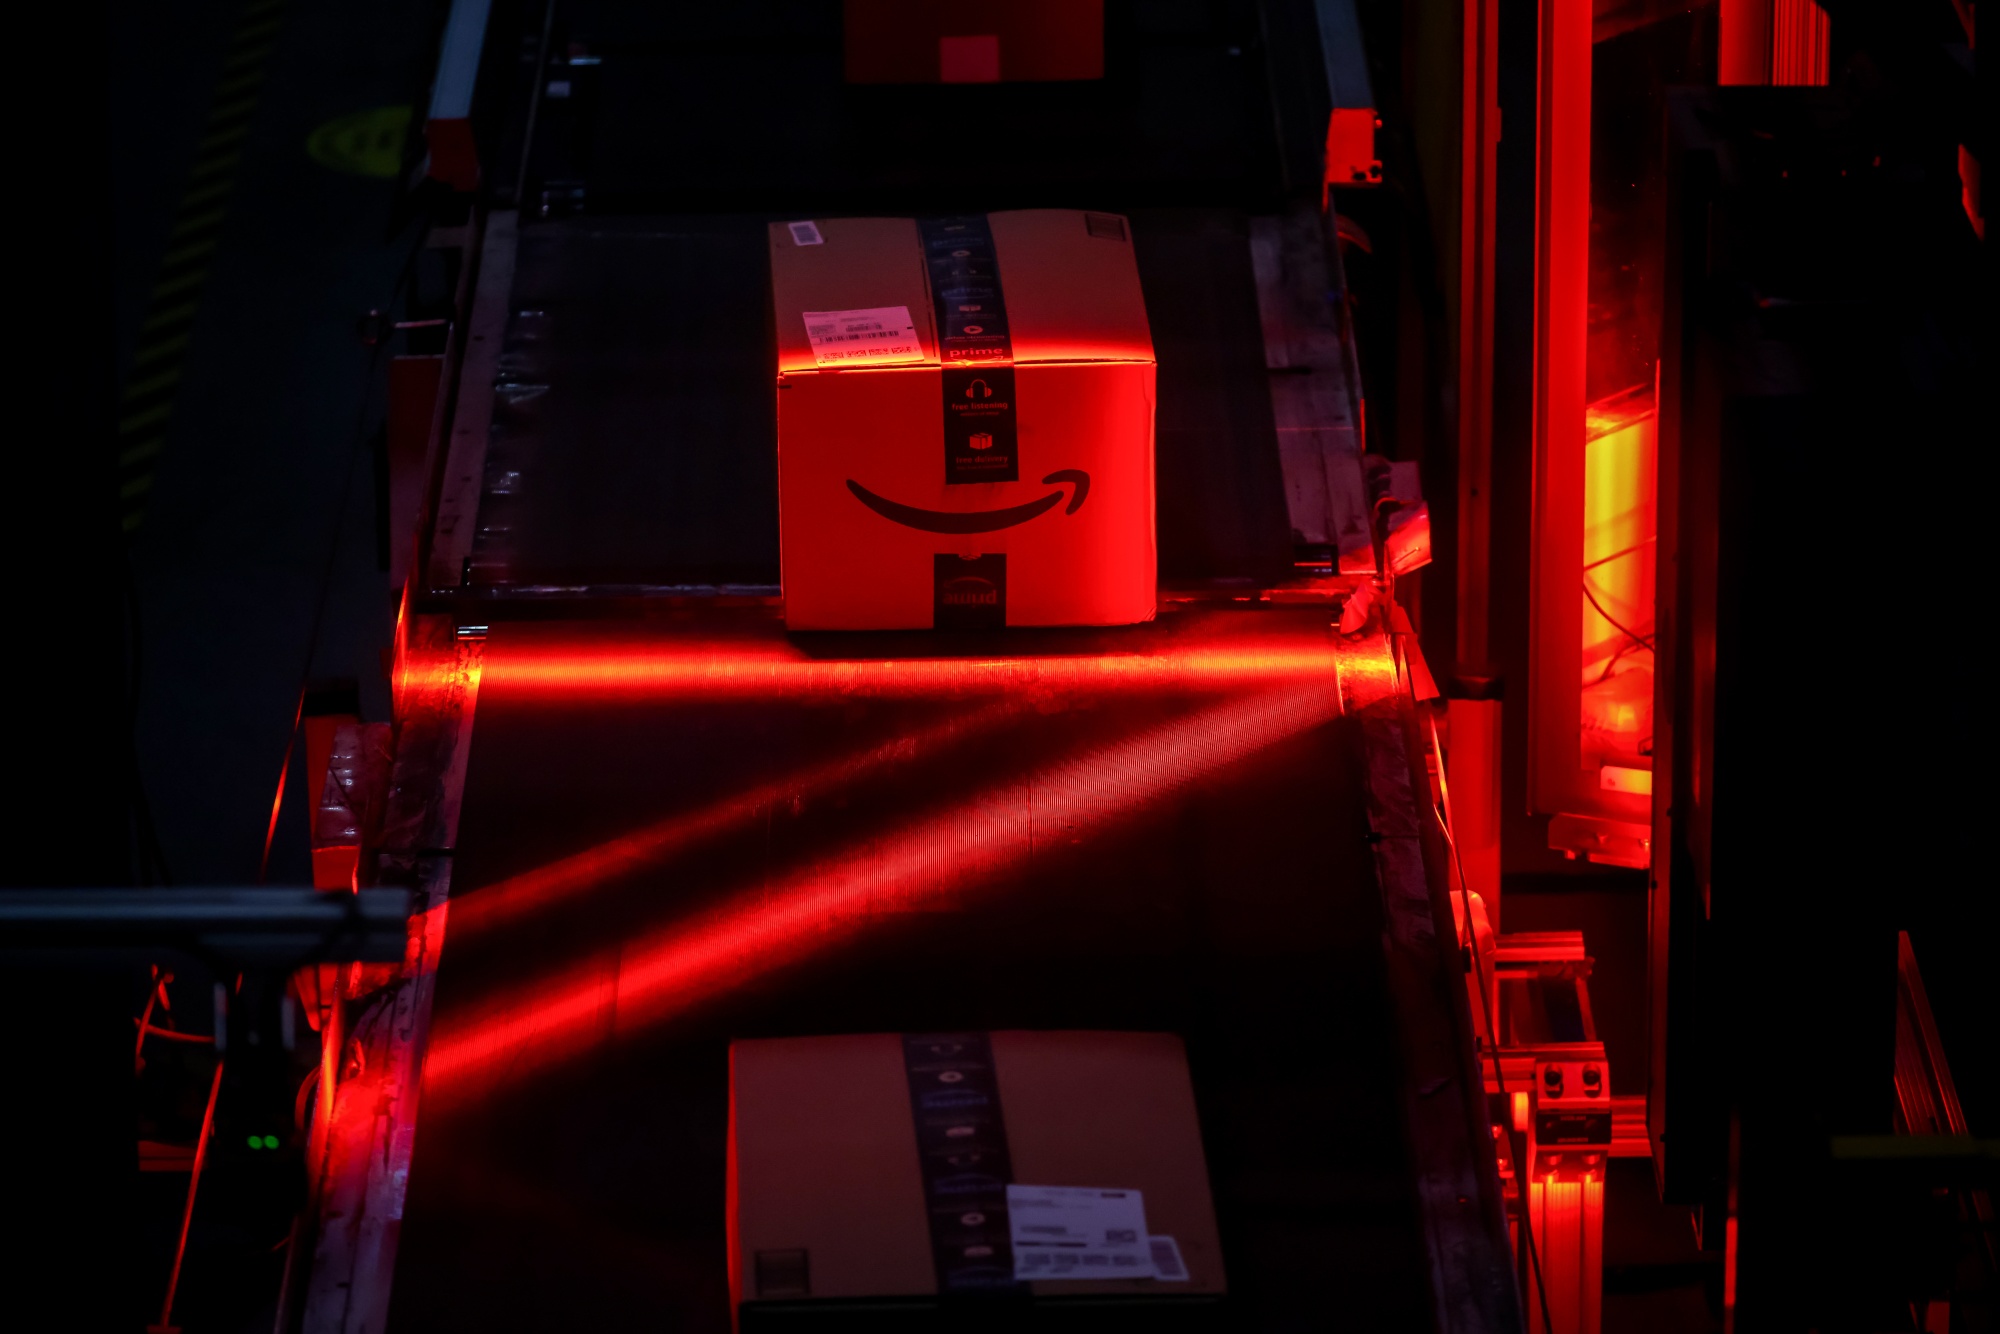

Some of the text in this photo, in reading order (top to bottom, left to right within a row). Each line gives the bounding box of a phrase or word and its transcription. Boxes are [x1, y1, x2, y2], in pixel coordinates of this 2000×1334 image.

[949, 347, 1003, 358] prime
[951, 402, 1008, 411] free listening
[974, 456, 1009, 464] delivery
[942, 589, 997, 608] prime
